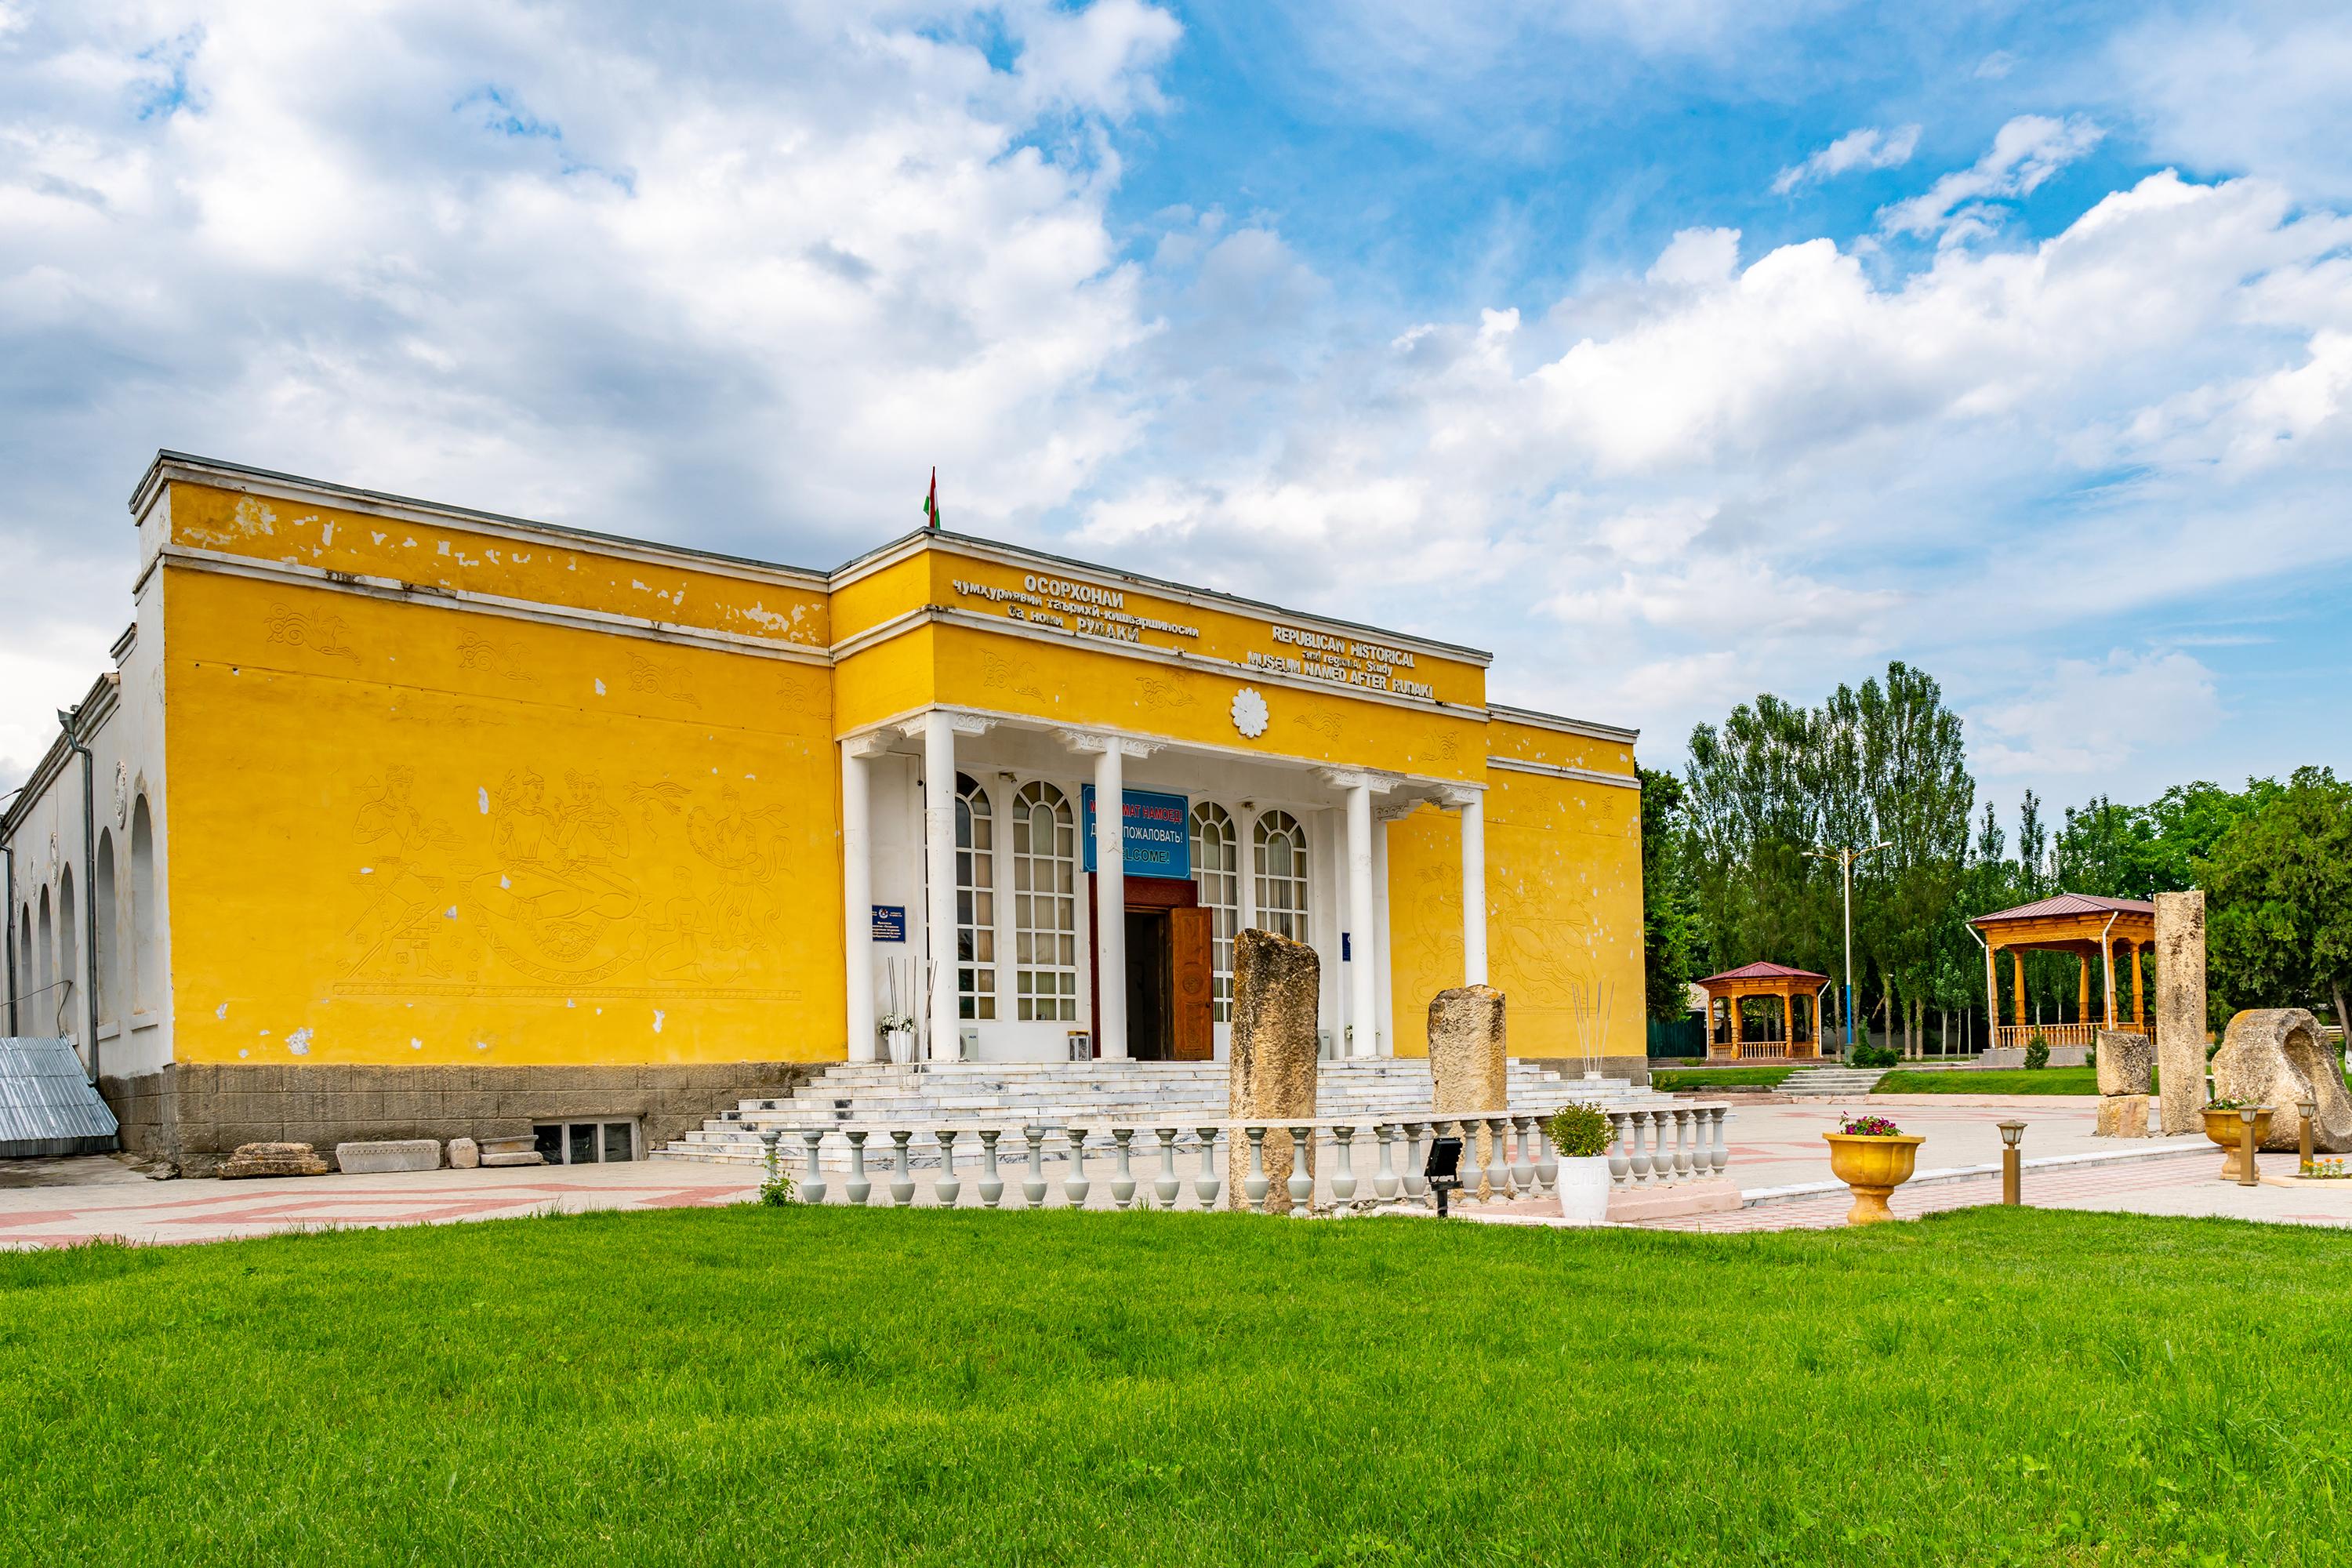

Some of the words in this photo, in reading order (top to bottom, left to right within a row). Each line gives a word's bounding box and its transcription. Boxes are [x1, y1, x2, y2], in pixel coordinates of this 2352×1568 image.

[1024, 575, 1123, 608] ОСОРХОНАИ
[1272, 626, 1345, 655] REPUBLICAN
[1350, 641, 1415, 669] HISTORICAL
[1247, 651, 1301, 674] MUSEUM
[1304, 661, 1347, 682] NAMED
[1349, 670, 1387, 690] AFTER
[1392, 677, 1434, 699] RUDAKI
[1301, 649, 1321, 662] and
[1366, 659, 1393, 677] Study
[1143, 807, 1182, 824] НАМОЕД!
[1123, 826, 1183, 844] ПОЖАЛОВАТЬ!
